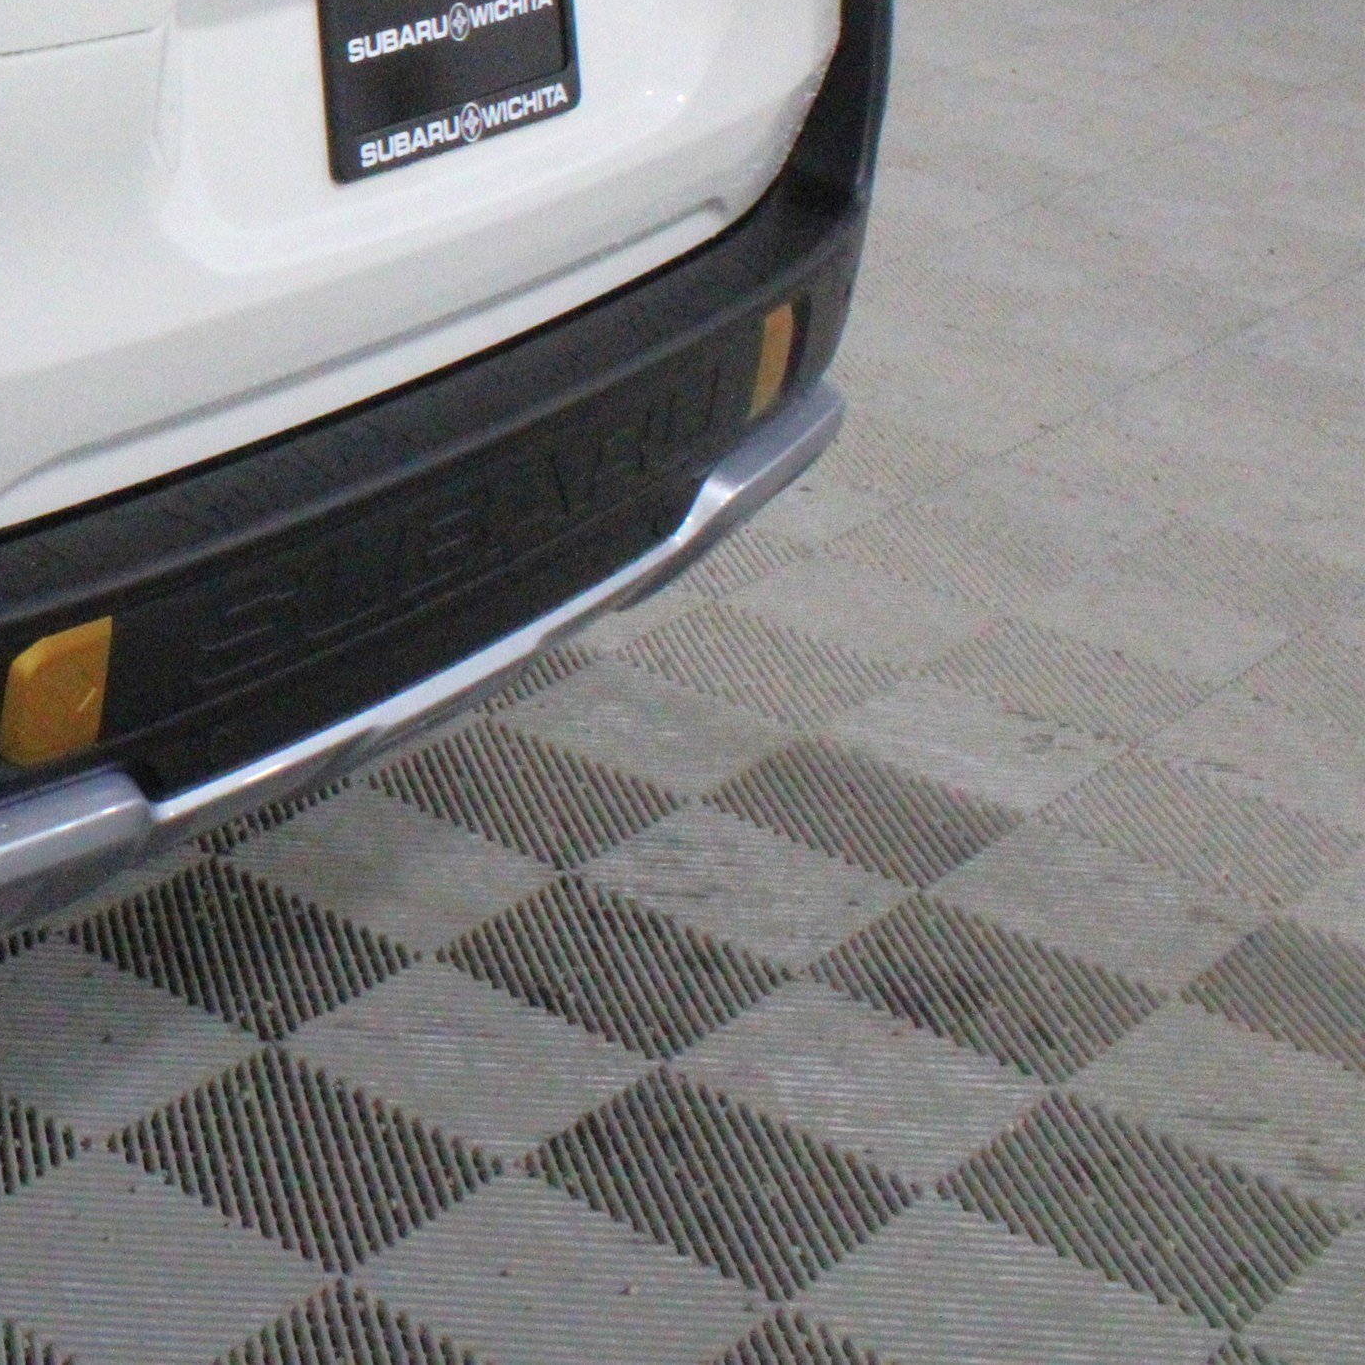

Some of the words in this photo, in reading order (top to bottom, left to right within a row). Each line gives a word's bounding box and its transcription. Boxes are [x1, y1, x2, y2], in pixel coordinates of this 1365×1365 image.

[346, 18, 449, 64] SUBARU
[359, 115, 462, 168] SUBARU
[480, 83, 569, 130] WICHITA
